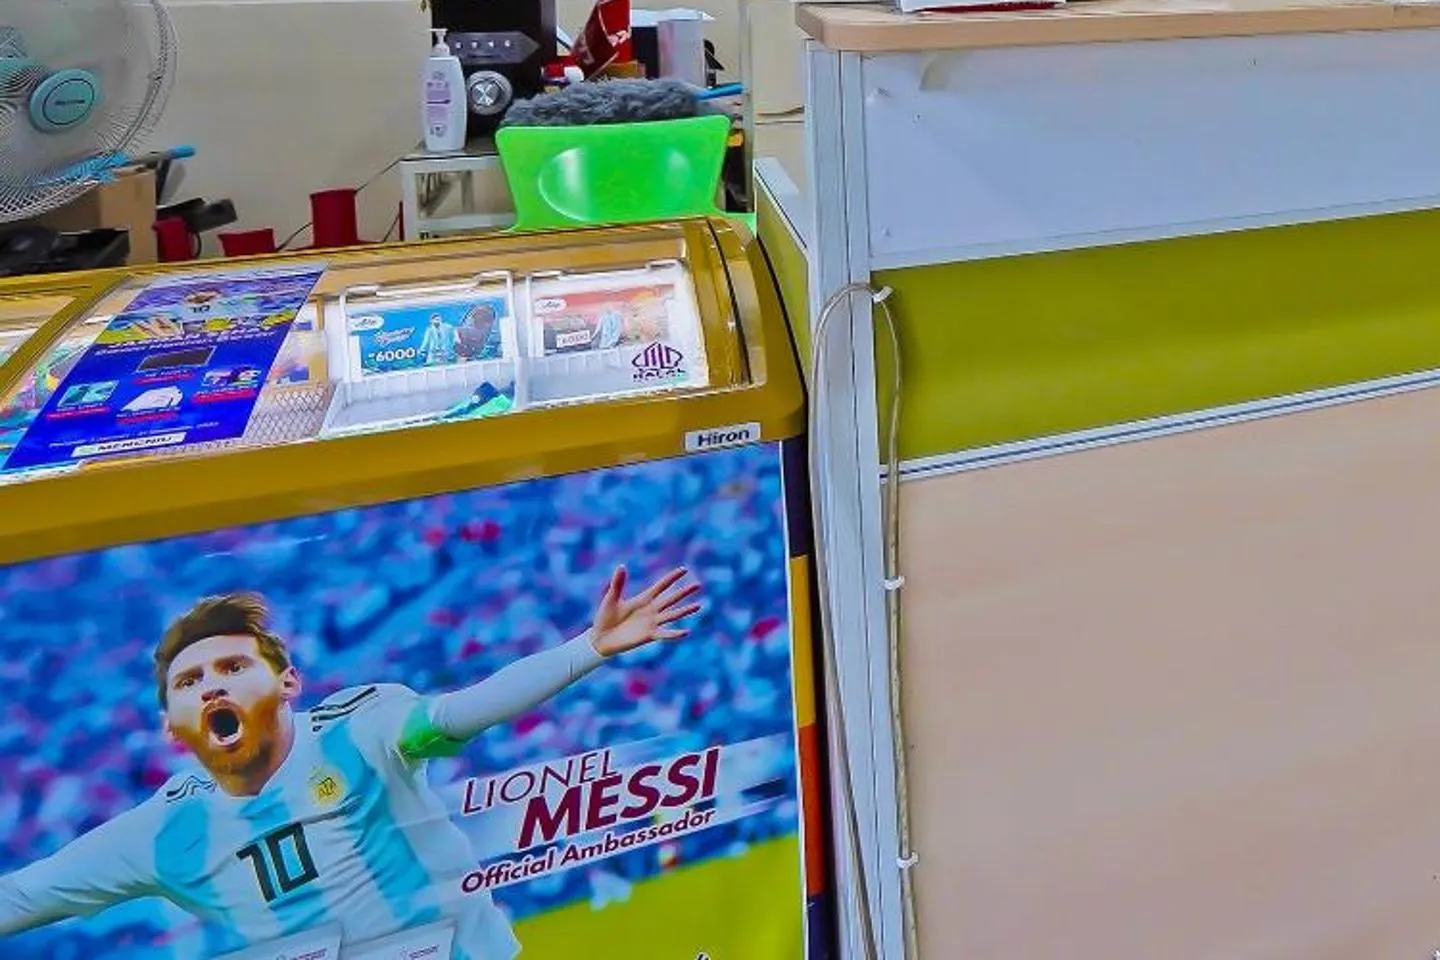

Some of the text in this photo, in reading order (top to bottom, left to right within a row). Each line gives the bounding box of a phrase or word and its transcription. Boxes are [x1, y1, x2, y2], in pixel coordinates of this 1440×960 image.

[697, 426, 750, 448] Hiron
[462, 748, 617, 815] LIONEL
[518, 747, 721, 851] MESSI
[236, 822, 320, 903] 10
[461, 808, 716, 894] Official Ambassador
